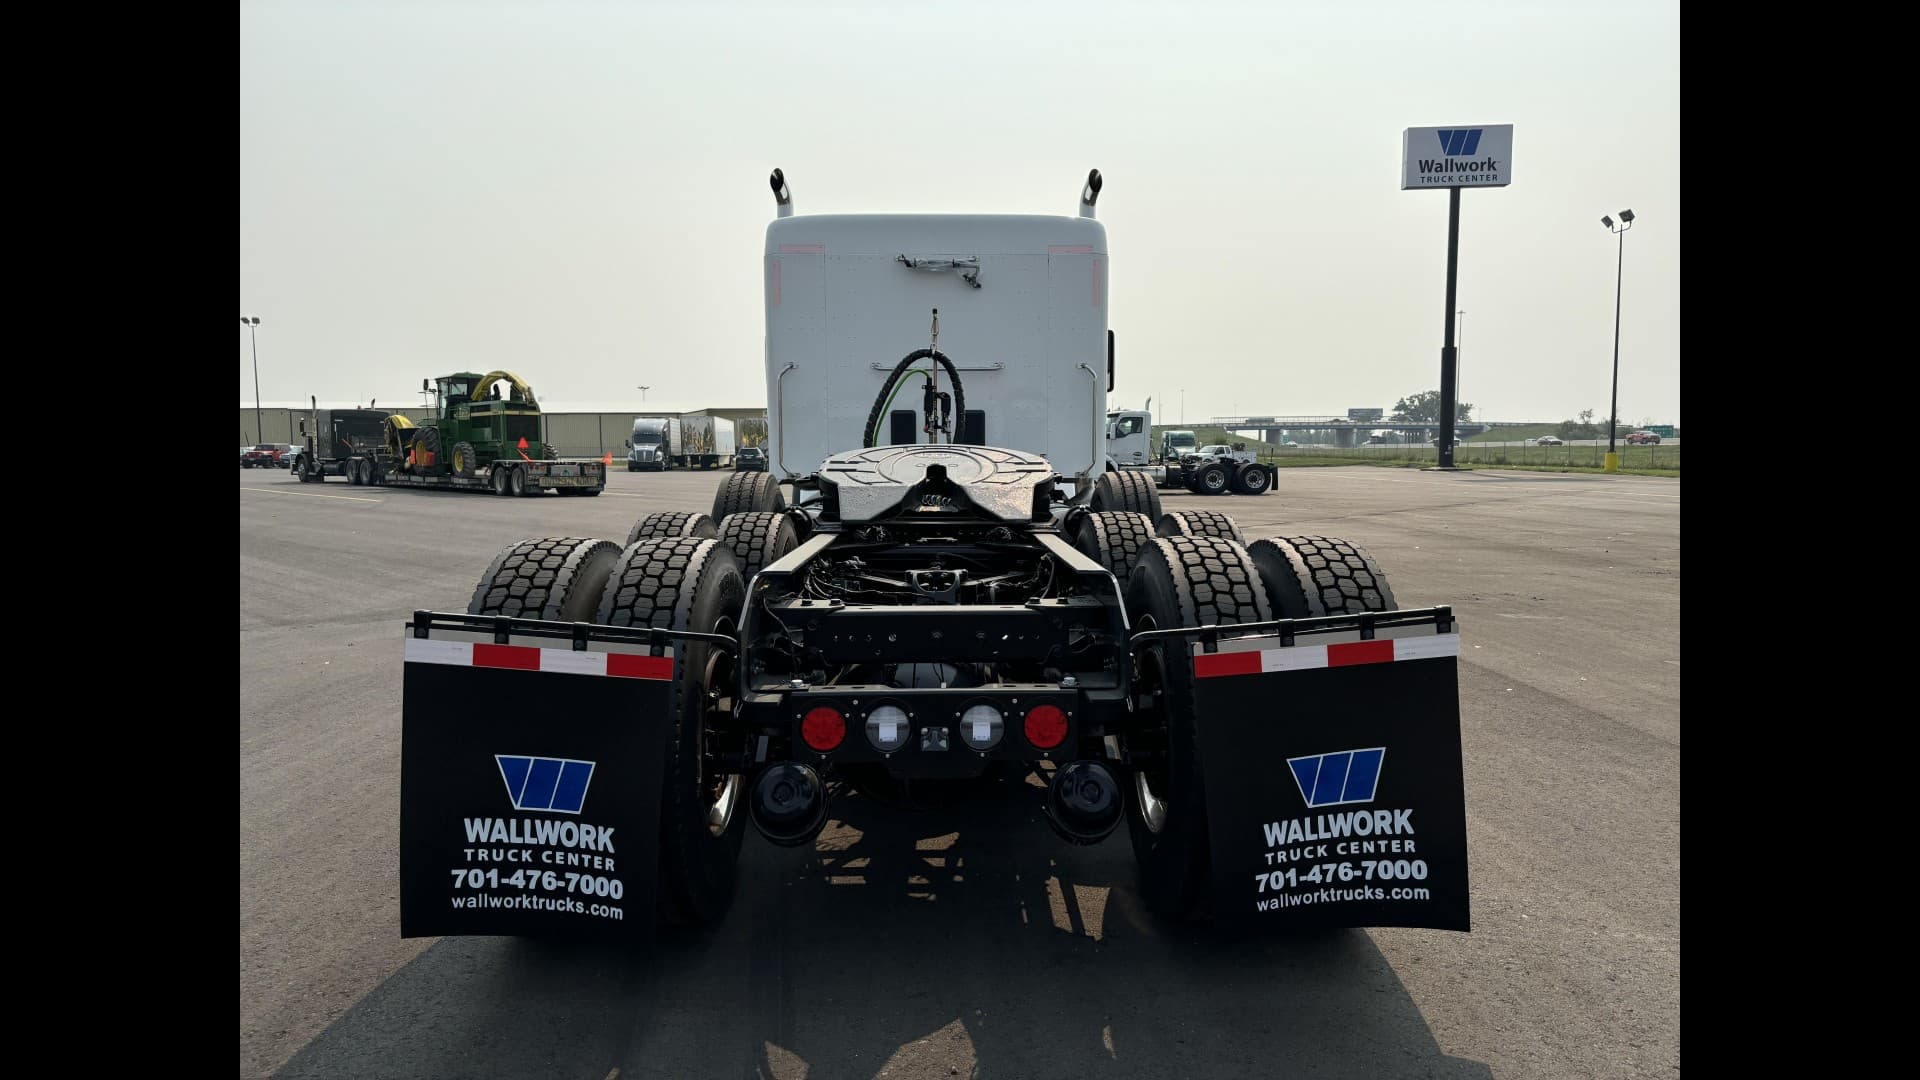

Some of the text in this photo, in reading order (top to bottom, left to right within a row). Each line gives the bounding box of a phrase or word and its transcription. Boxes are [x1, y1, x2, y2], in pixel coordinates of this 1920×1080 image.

[1418, 157, 1497, 174] Wallwork
[1420, 174, 1498, 184] TRUCK CENTER
[464, 818, 615, 853] WALLWORK
[1263, 808, 1414, 848] WALLWORK
[464, 848, 615, 872] TRUCK CENTER
[1265, 839, 1416, 865] TRUCK CENTER
[451, 868, 624, 899] 701-476-7000
[1256, 859, 1428, 893] 701-476-7000
[451, 893, 623, 920] wallworktrucks.com
[1256, 884, 1430, 912] wallworktrucks.com
